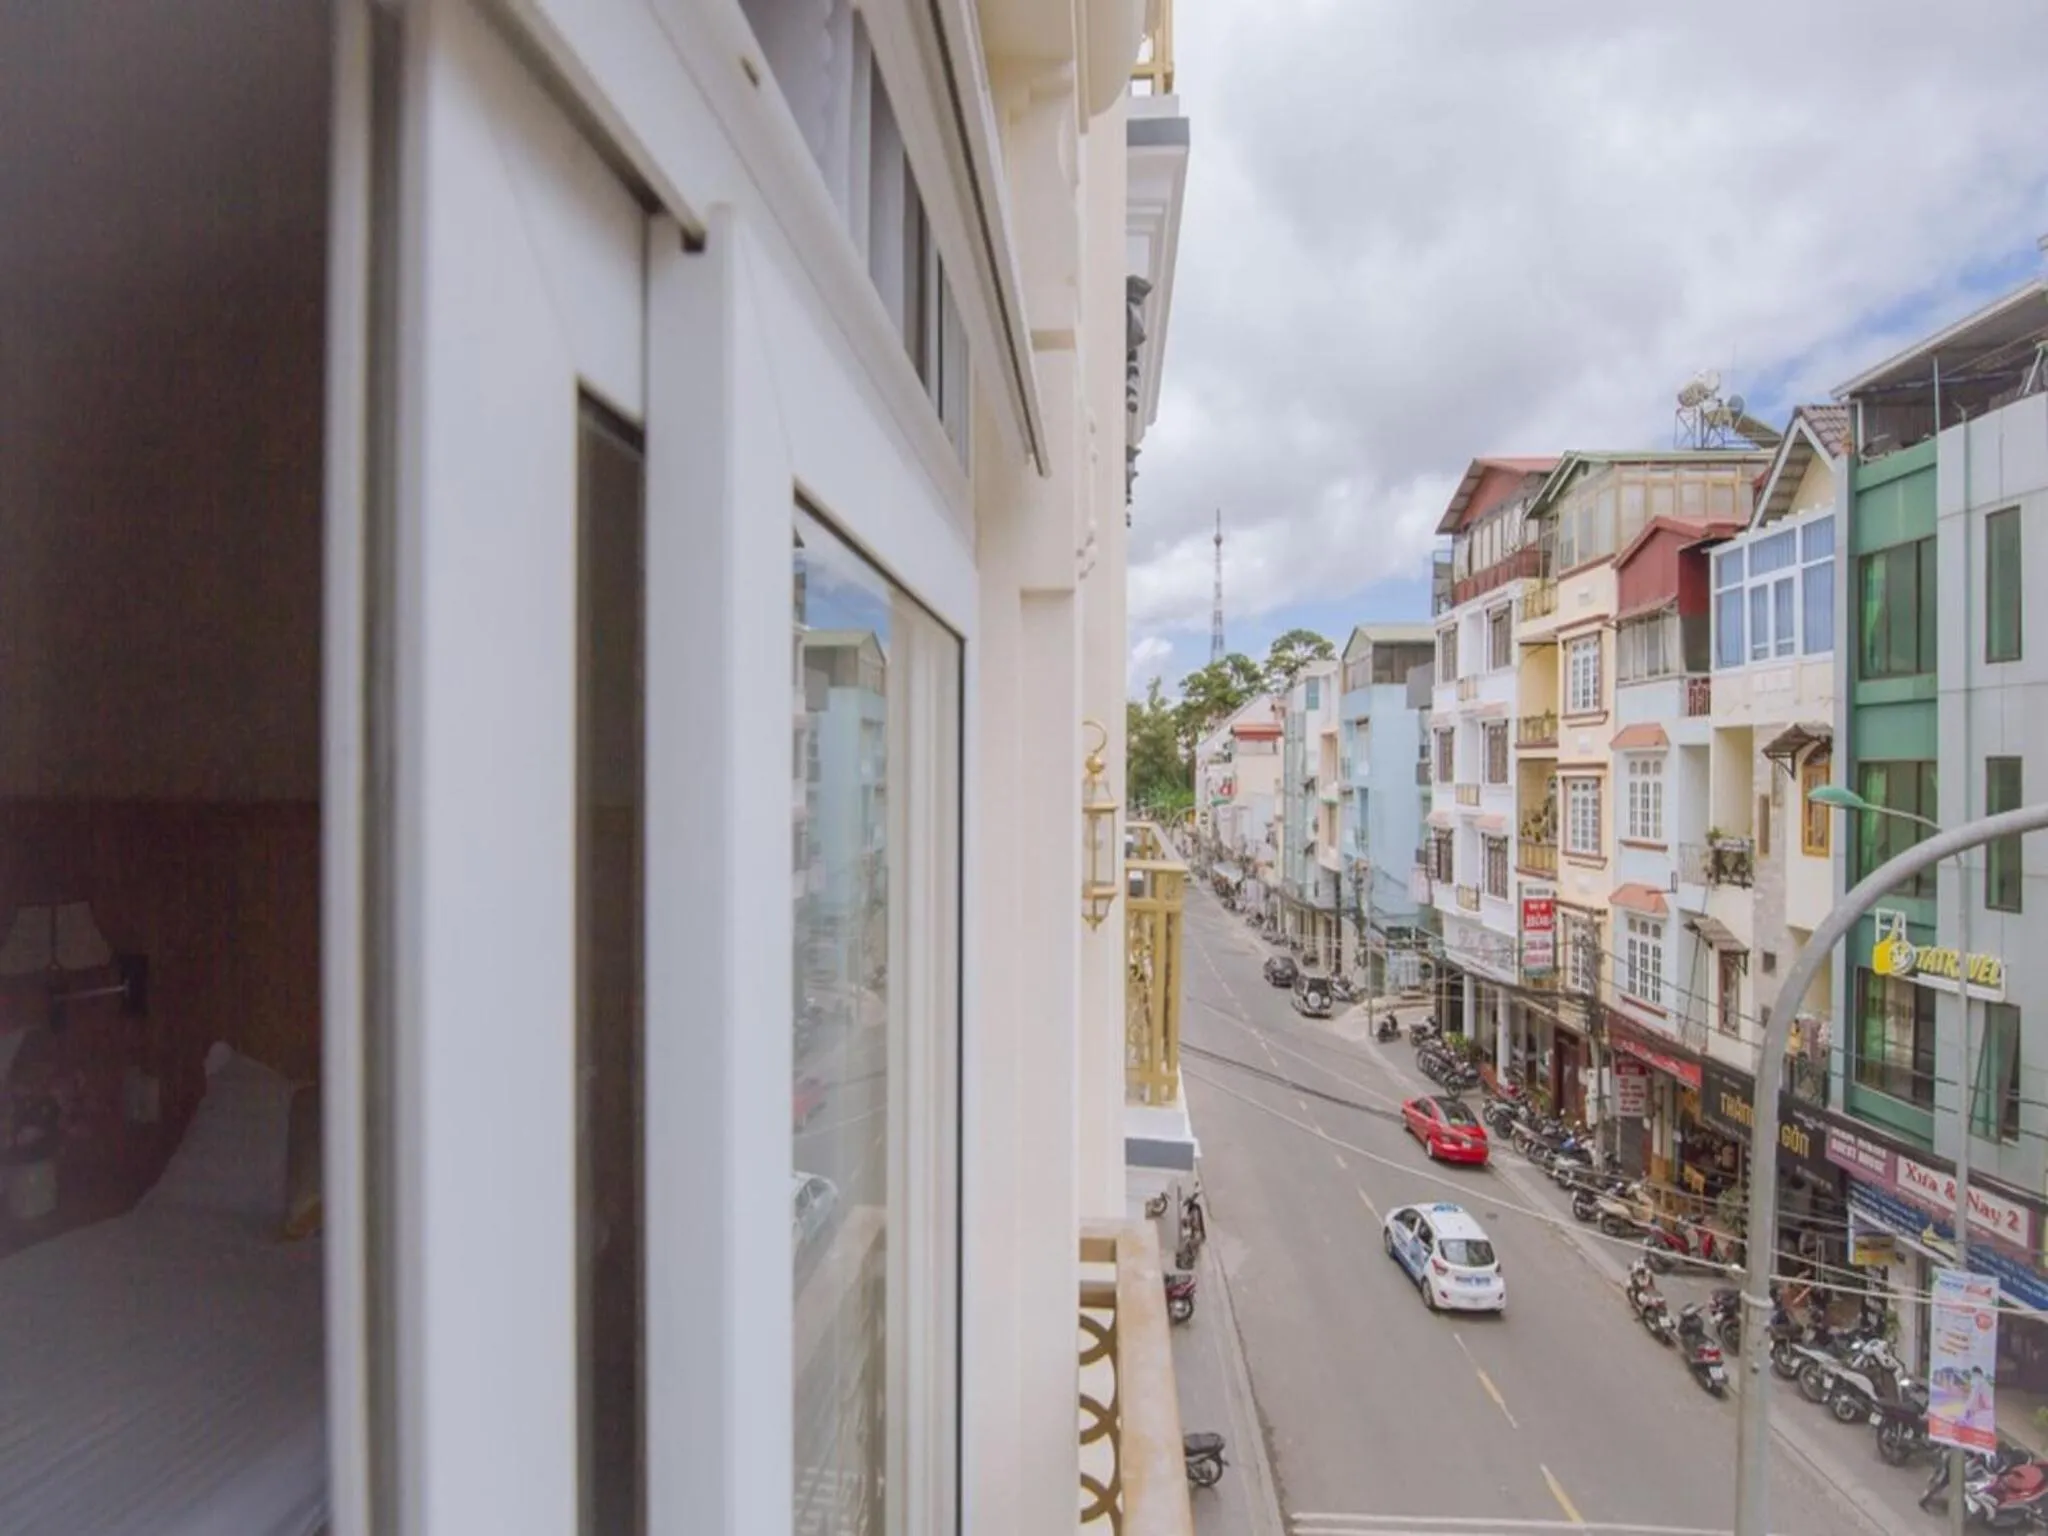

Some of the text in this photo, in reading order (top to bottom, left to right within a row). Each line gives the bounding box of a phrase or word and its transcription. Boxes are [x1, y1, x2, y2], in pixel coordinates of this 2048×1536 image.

[1944, 1178, 1957, 1202] &
[1966, 1188, 2002, 1227] Nay
[2007, 1208, 2021, 1232] 2
